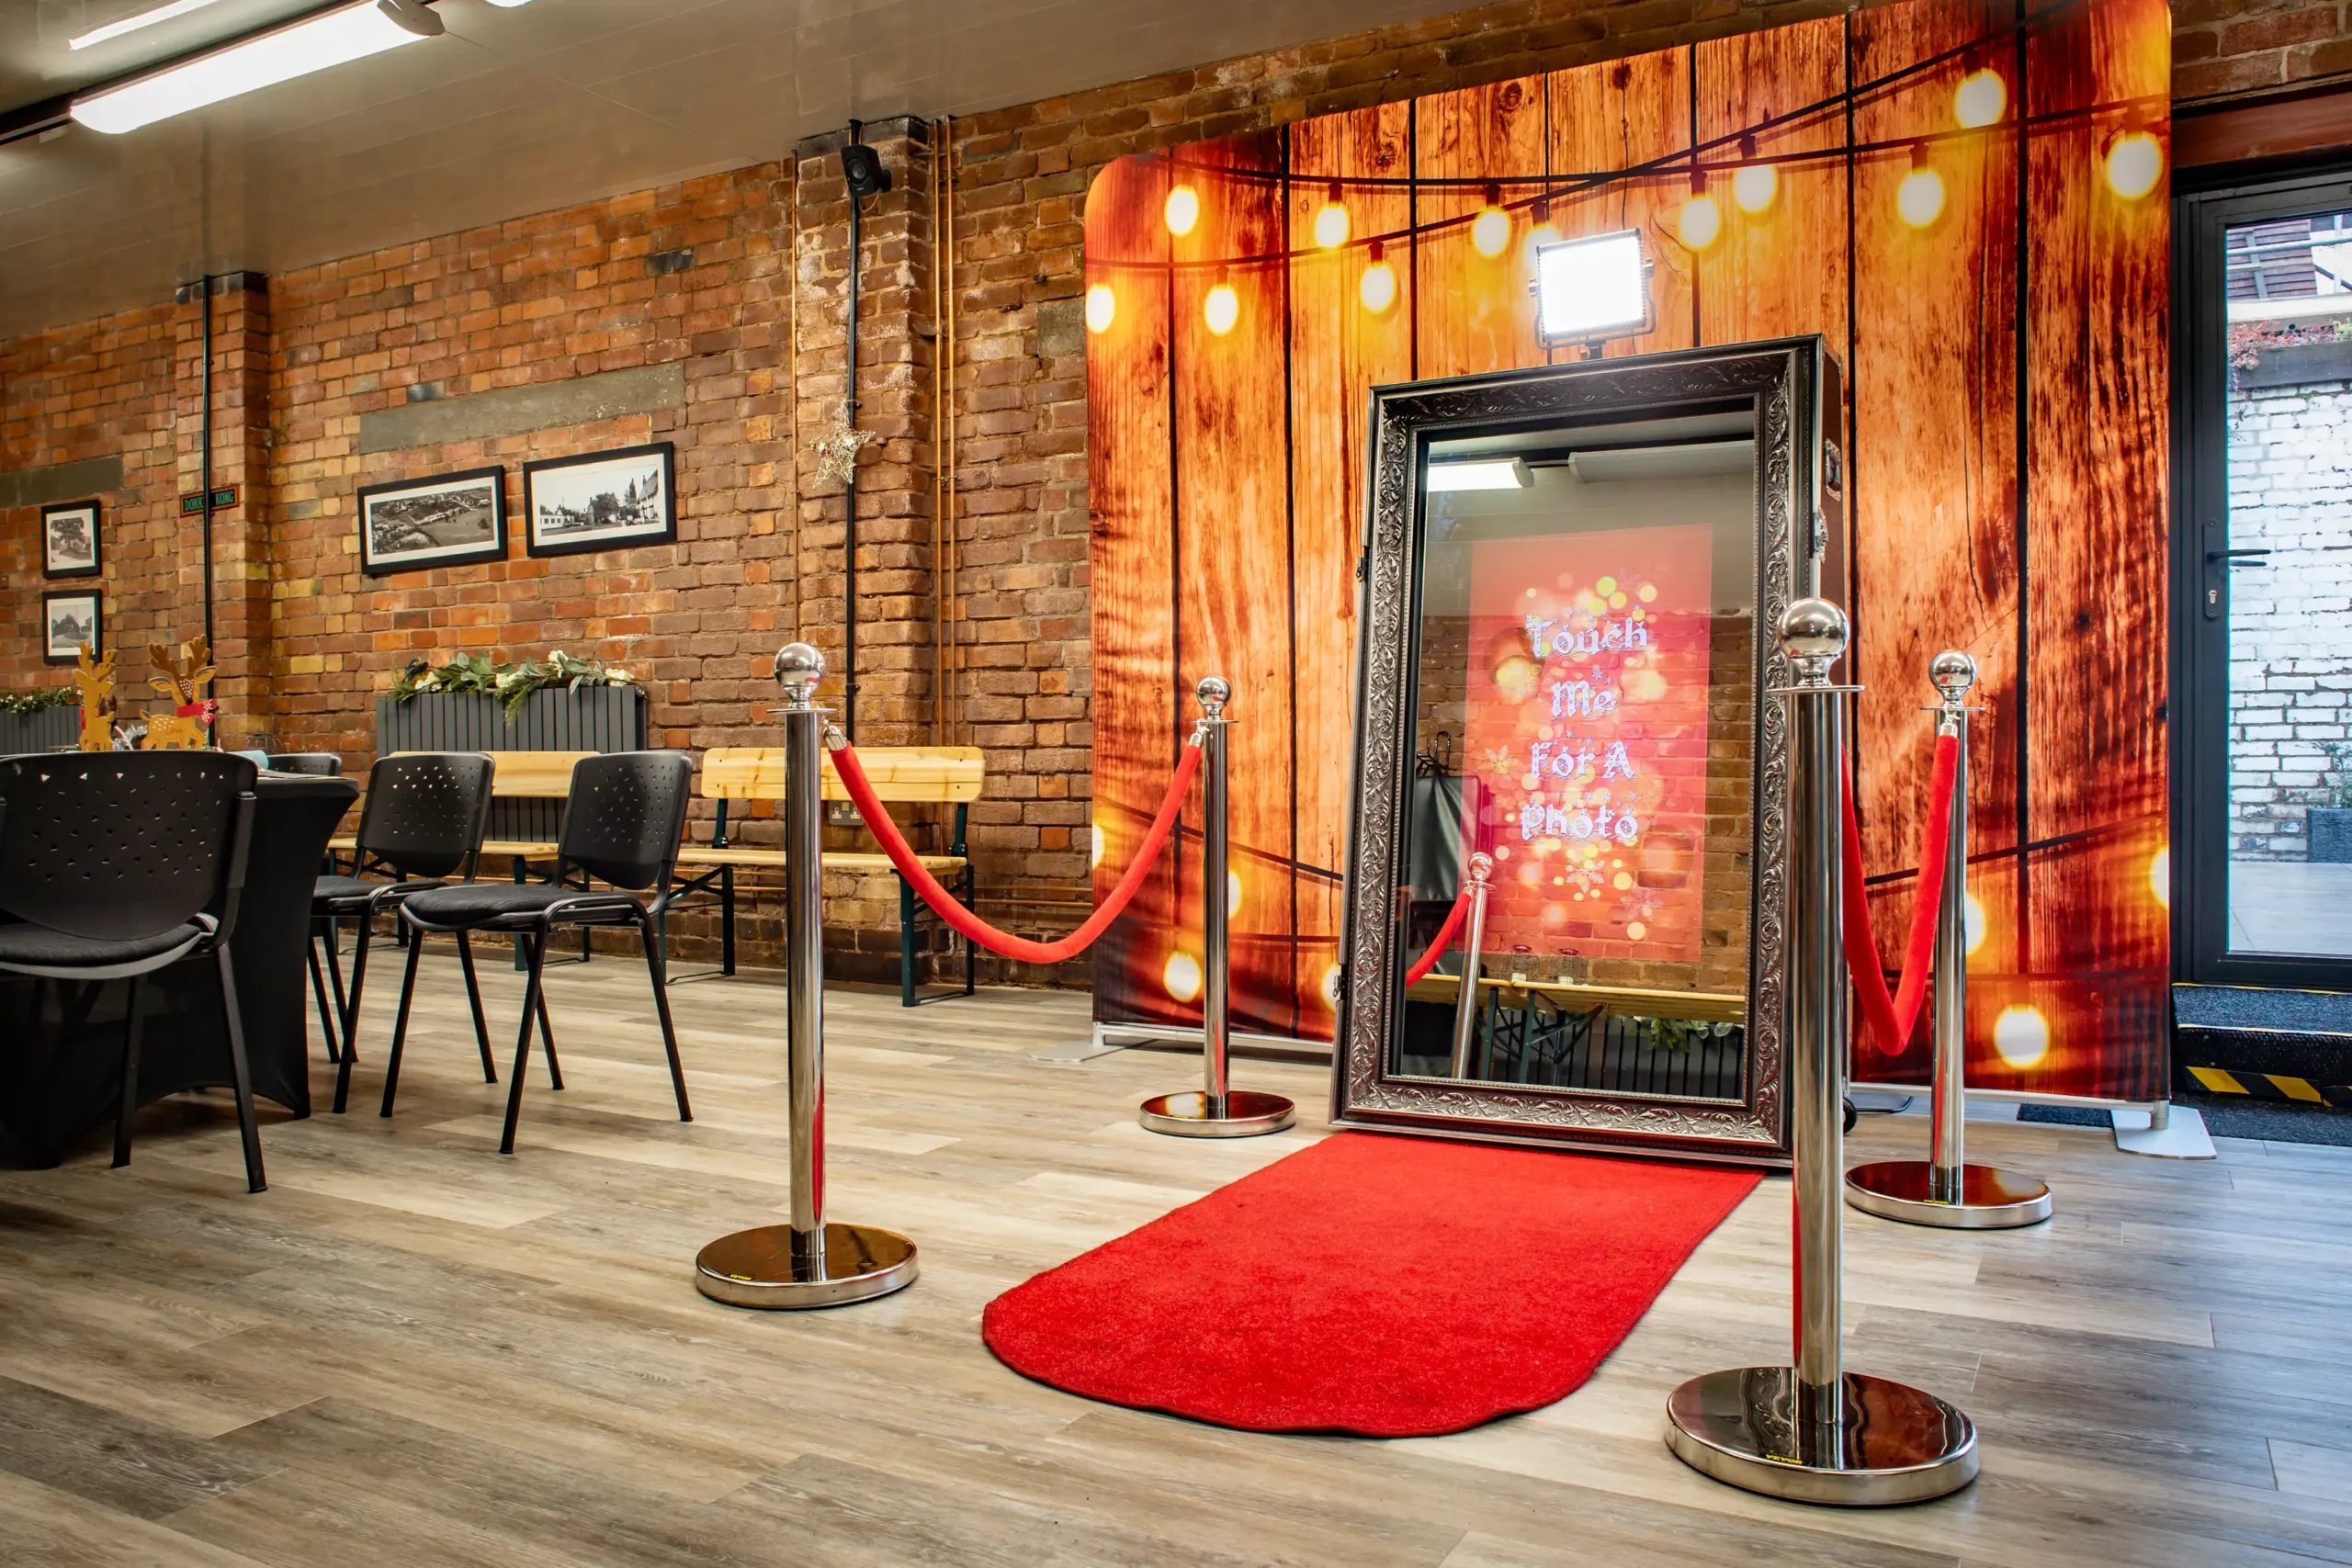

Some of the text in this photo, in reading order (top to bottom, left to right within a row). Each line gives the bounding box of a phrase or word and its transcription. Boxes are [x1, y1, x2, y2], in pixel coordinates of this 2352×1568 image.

[185, 491, 234, 512] DONK KONG
[1526, 615, 1647, 659] Touch
[1550, 680, 1619, 718] Me
[1530, 740, 1635, 780] For A
[1521, 802, 1639, 841] Photo
[1765, 1453, 1804, 1465] VEVOR
